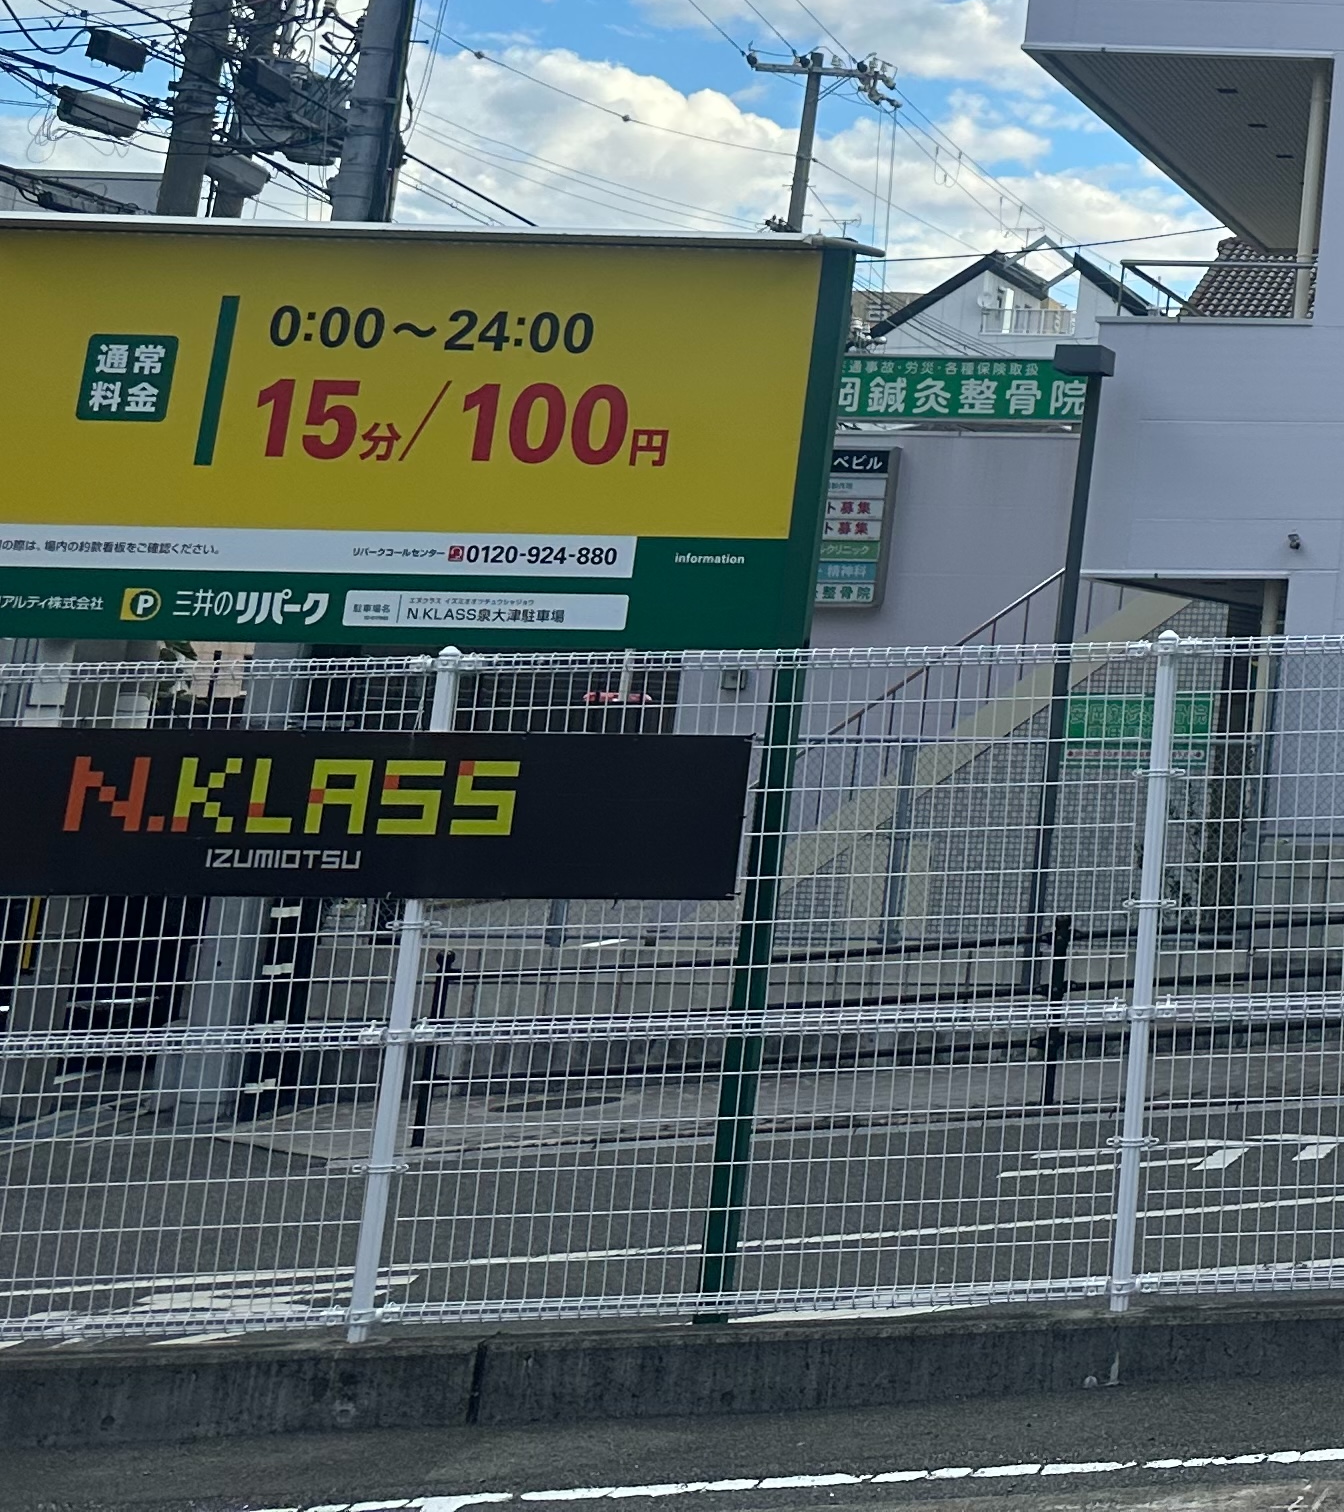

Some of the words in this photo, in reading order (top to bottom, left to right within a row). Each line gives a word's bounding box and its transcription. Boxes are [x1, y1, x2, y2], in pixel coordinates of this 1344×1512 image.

[95, 343, 167, 376] 通常
[843, 361, 1039, 376] 通事故・労災・各種保険取扱
[88, 381, 161, 412] 料金
[466, 545, 618, 565] 0120-924-880
[674, 551, 745, 565] information
[0, 595, 104, 610] アルティ株式会社
[62, 755, 521, 836] N.KLASS
[205, 848, 362, 869] IZUMIOTSU
